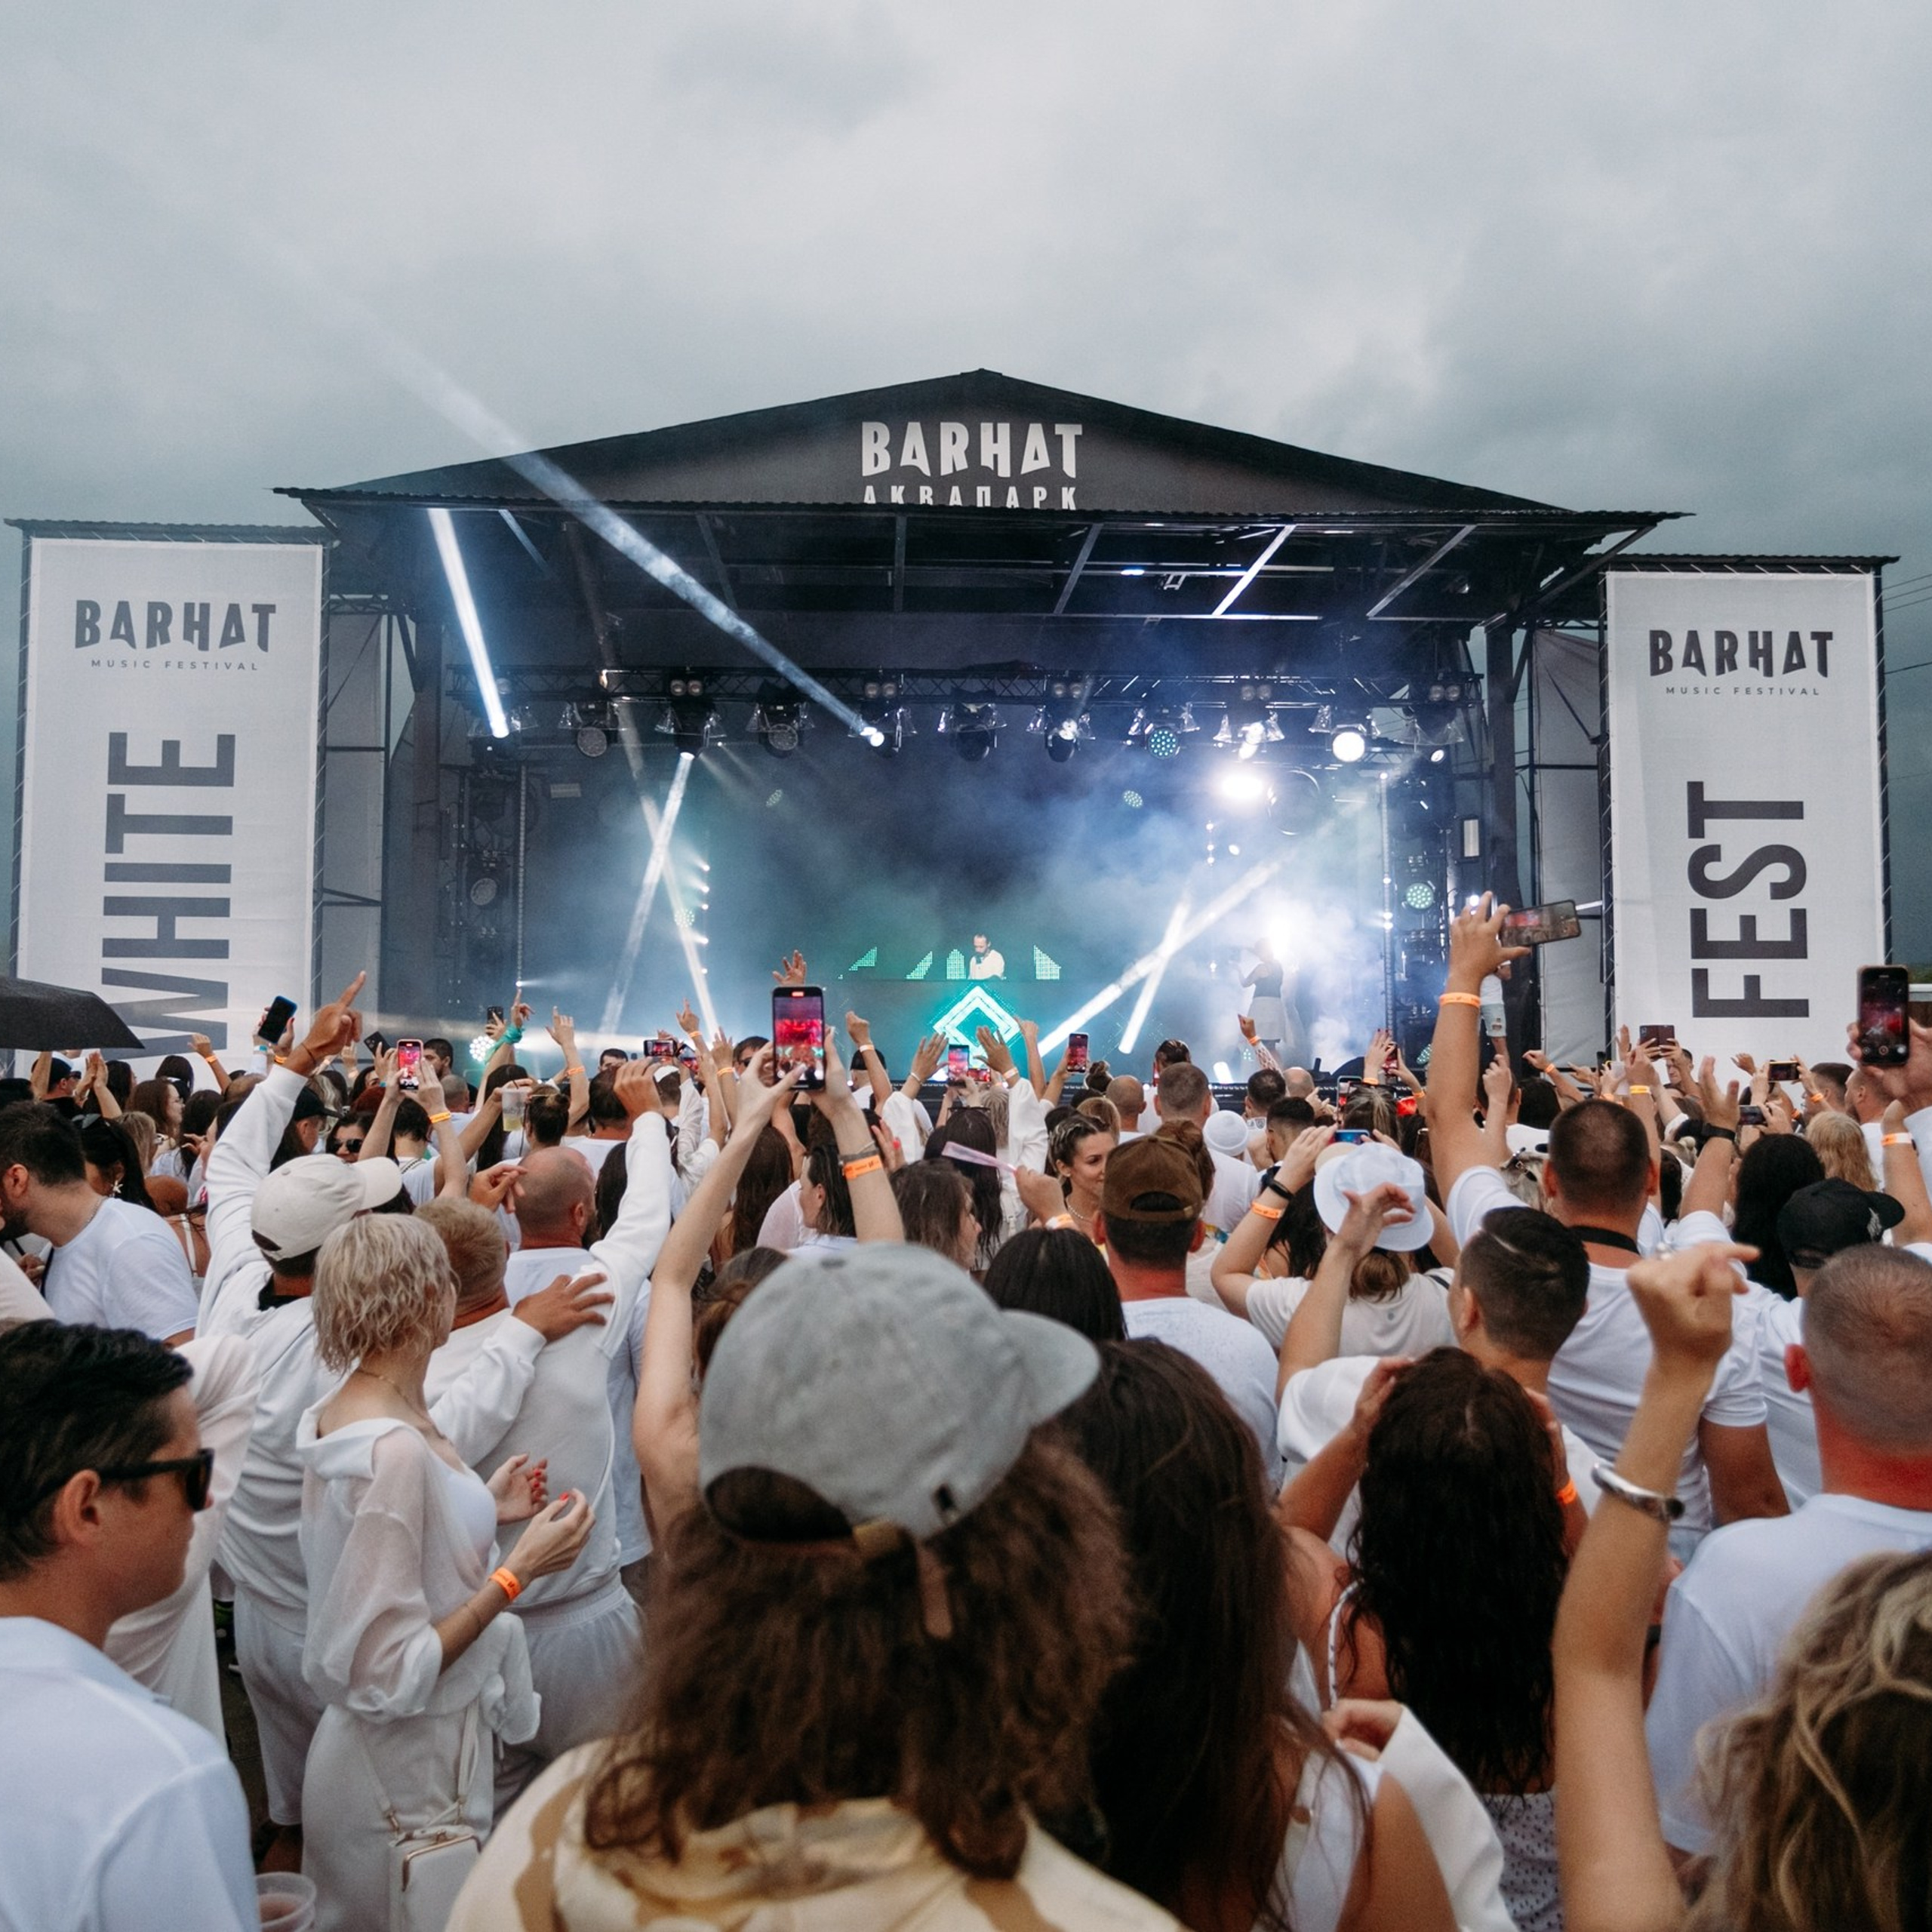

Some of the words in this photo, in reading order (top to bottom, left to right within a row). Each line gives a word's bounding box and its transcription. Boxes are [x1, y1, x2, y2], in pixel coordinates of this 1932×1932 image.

[861, 421, 1083, 479] BARHAT
[75, 599, 277, 653] BARHAT
[91, 659, 151, 669] MUSIC
[165, 660, 258, 671] FESTIVAL
[1648, 629, 1834, 678] BARHAT
[1665, 686, 1721, 696] MUSIC
[1734, 687, 1820, 697] FESTIVAL
[101, 731, 236, 1060] WHITE
[1687, 780, 1810, 1018] FEST
